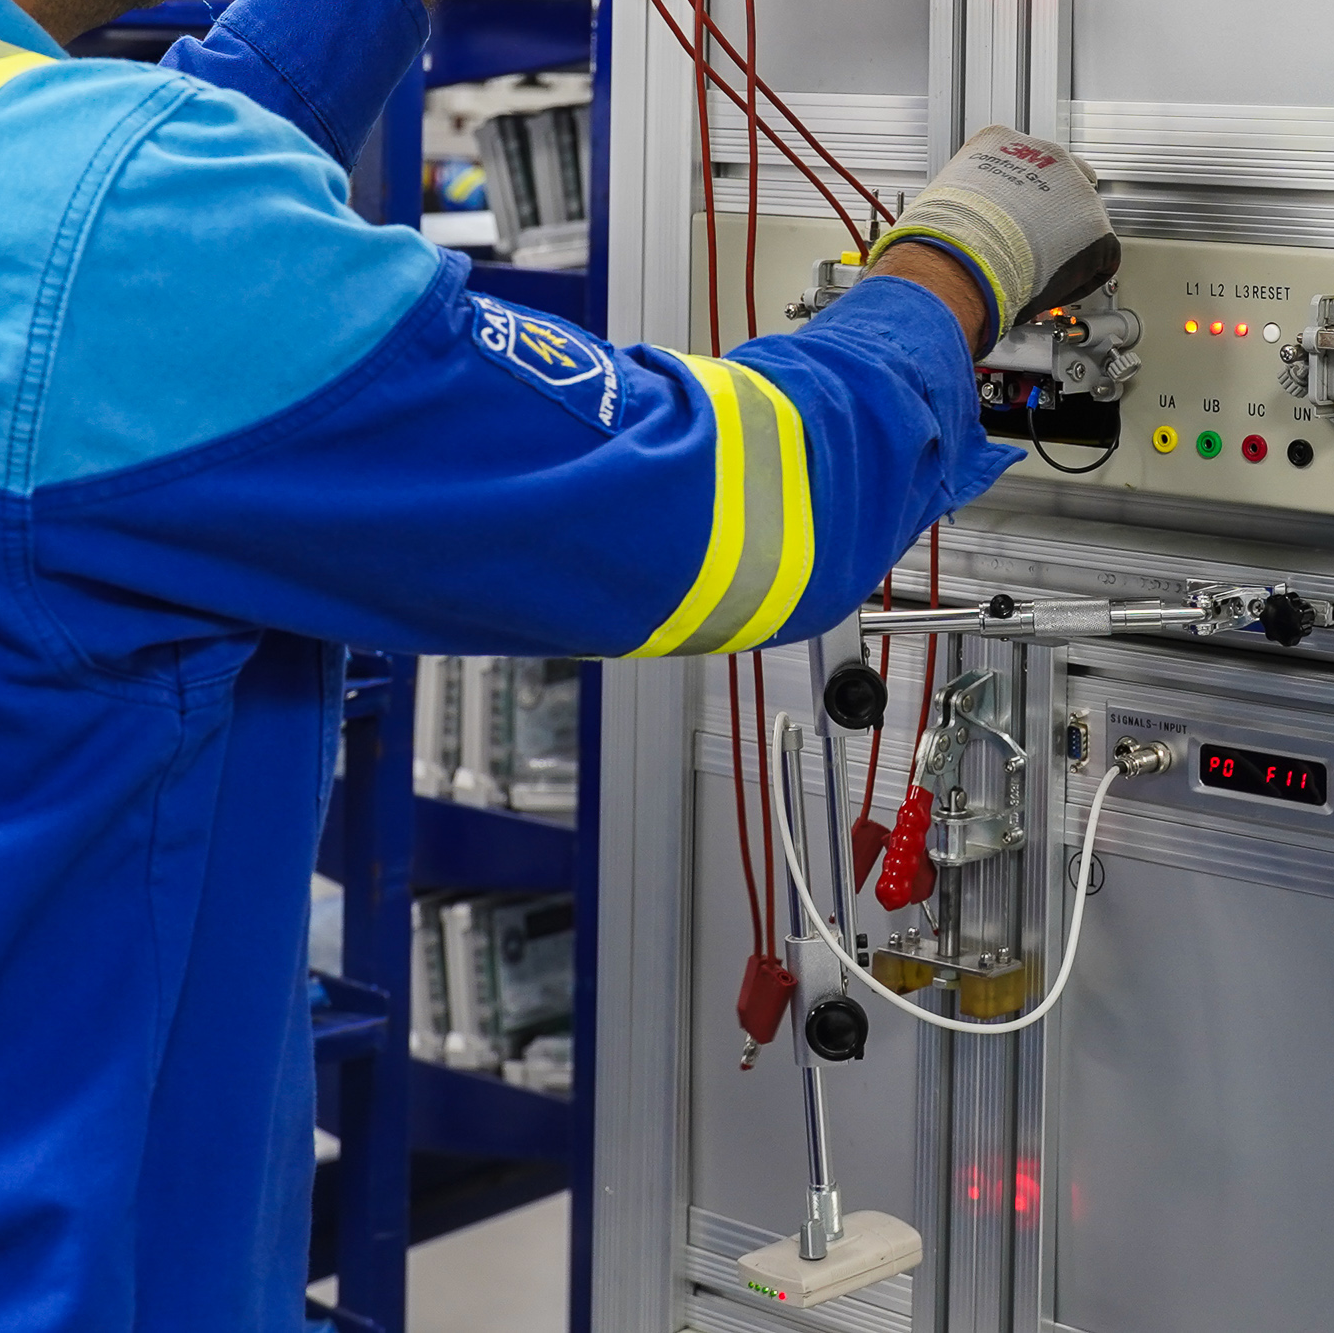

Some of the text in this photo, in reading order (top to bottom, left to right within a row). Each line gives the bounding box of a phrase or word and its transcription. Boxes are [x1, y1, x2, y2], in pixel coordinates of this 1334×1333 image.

[1000, 143, 1058, 169] 3M
[969, 153, 1051, 192] Comfort Grip
[978, 163, 1025, 186] Gloves
[1186, 282, 1290, 301] L1 L2 L3 RESET
[1159, 395, 1311, 421] UA UB UC UN
[1110, 713, 1188, 735] SIGNALS-INPUT
[1266, 766, 1308, 790] F11
